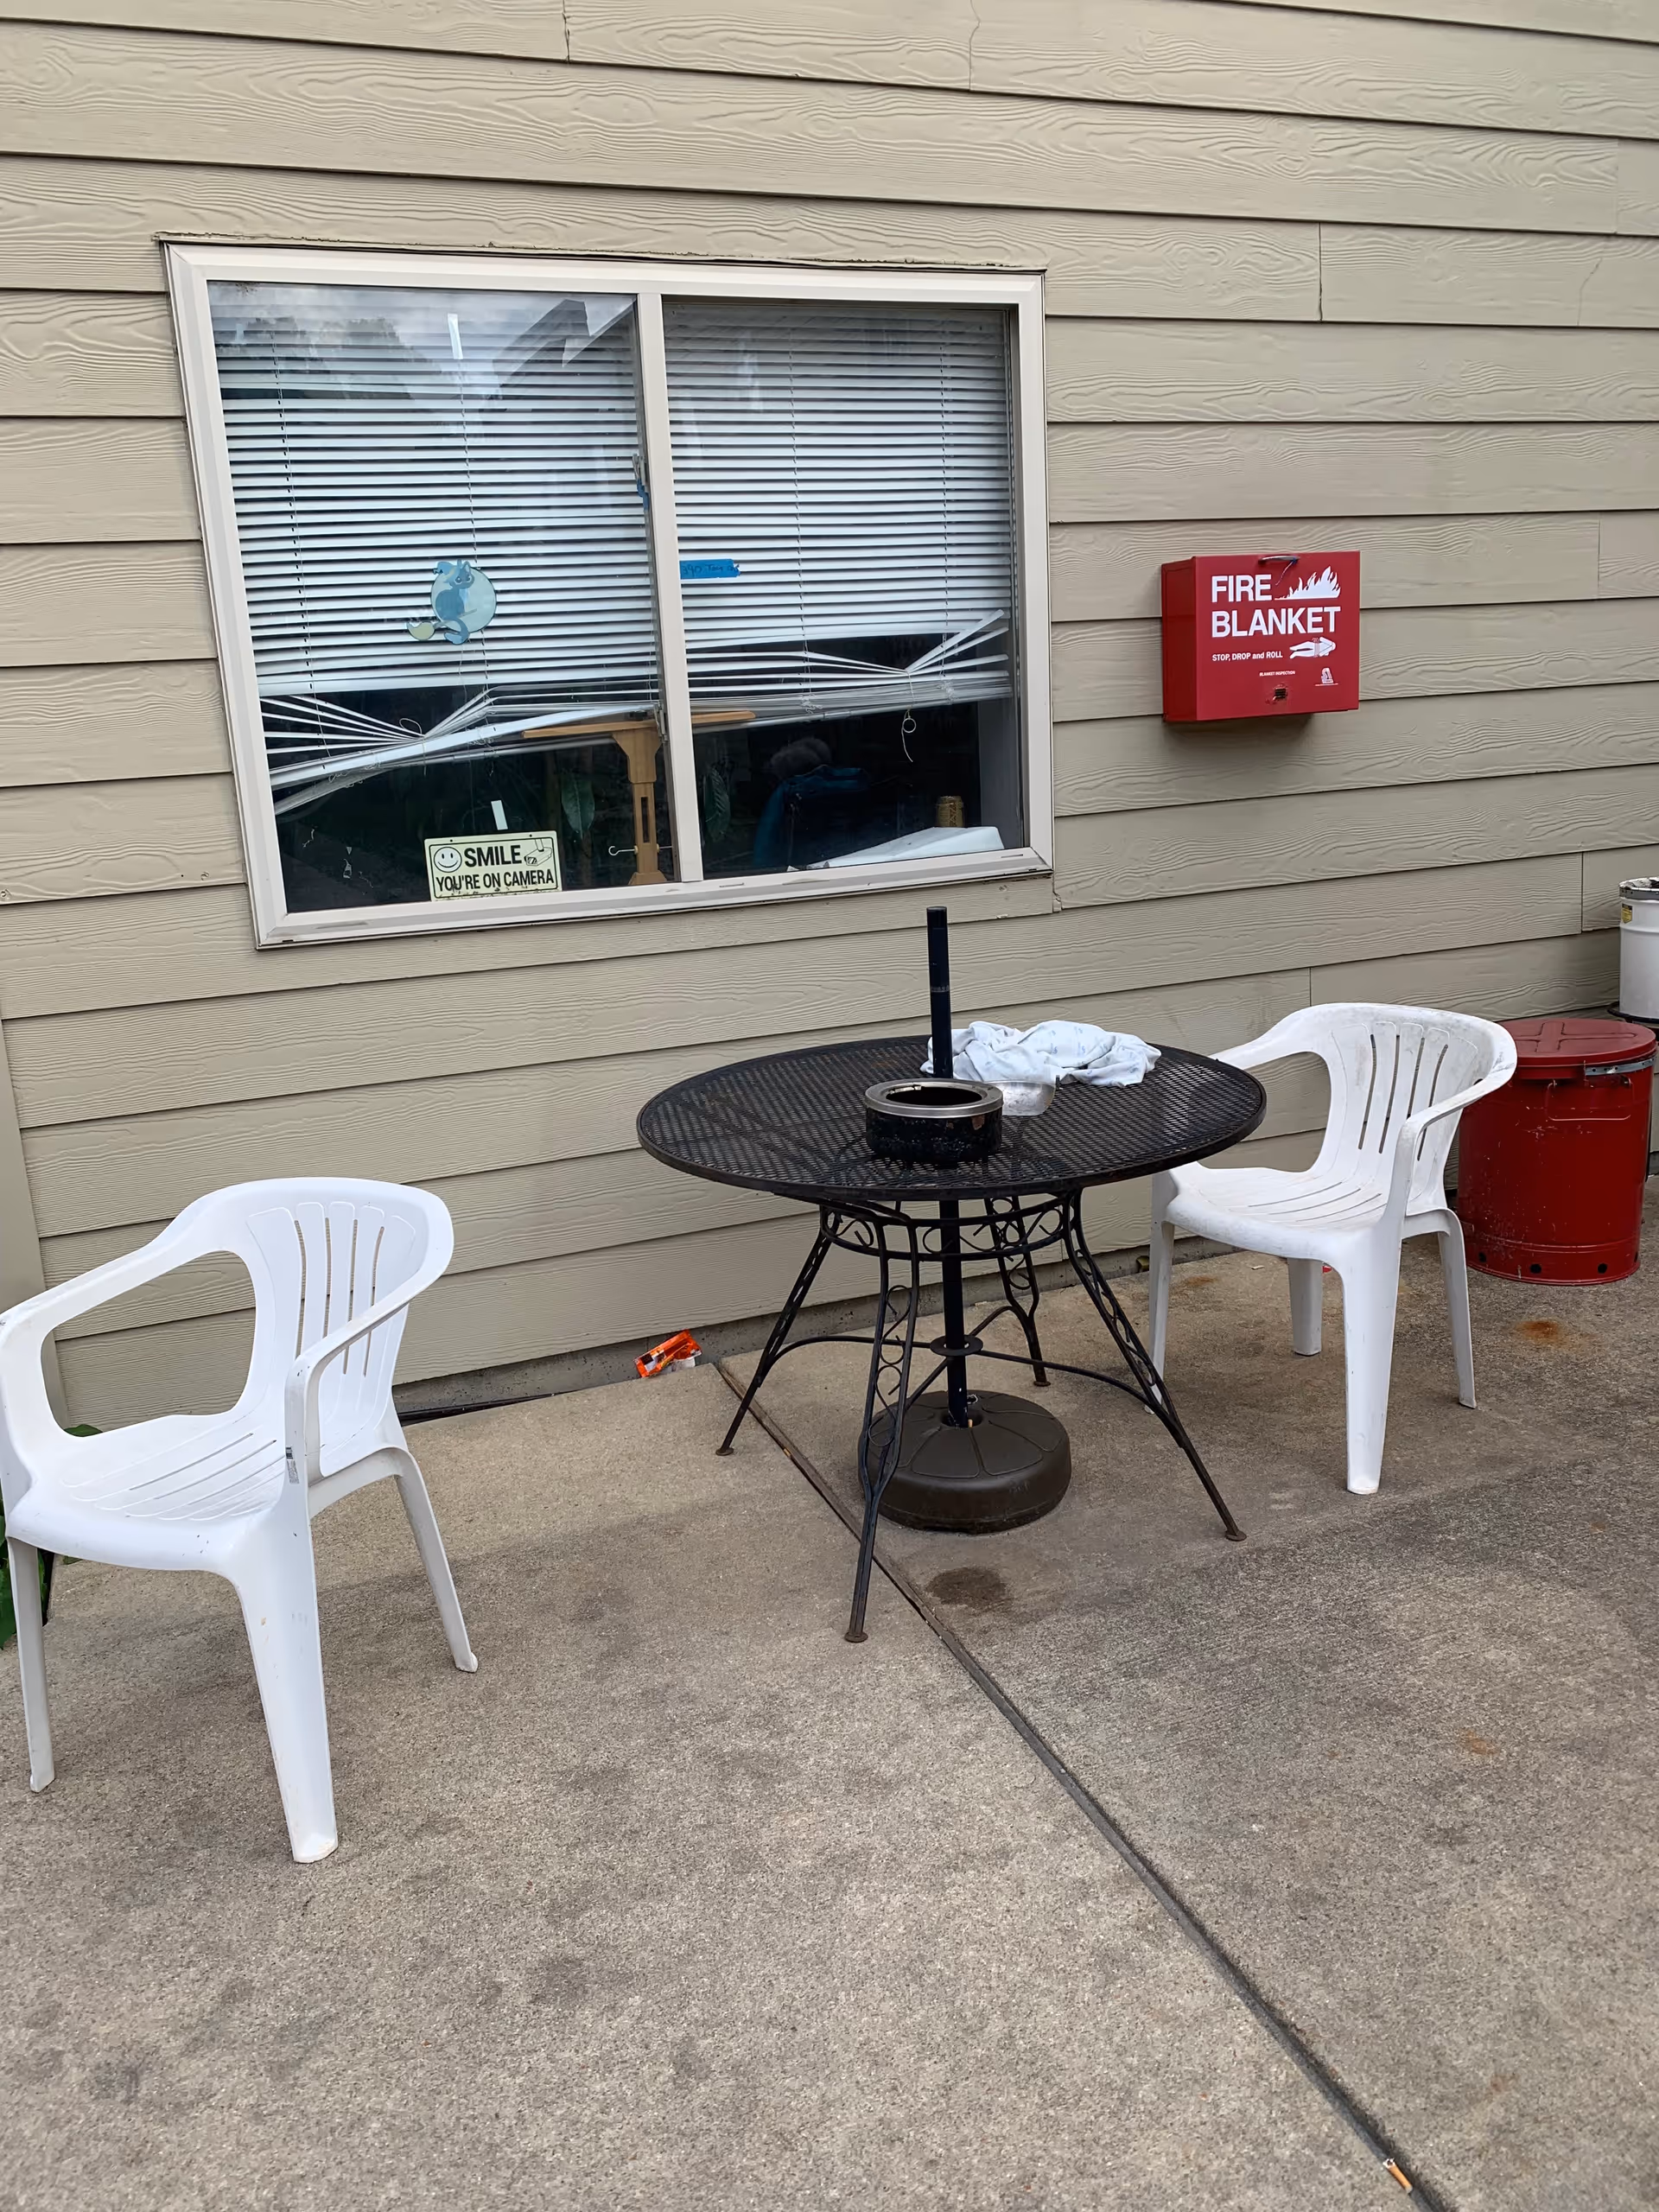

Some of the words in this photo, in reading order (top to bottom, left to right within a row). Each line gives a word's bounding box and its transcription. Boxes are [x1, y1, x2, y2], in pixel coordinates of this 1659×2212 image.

[1211, 574, 1272, 603] FIRE
[1211, 606, 1341, 638] BLANKET
[1211, 653, 1231, 662] STOP,
[1231, 652, 1251, 661] DROP
[463, 844, 523, 868] SMILE
[435, 874, 481, 892] YOU'RE
[482, 872, 501, 888] ON
[504, 868, 555, 887] CAMERA
